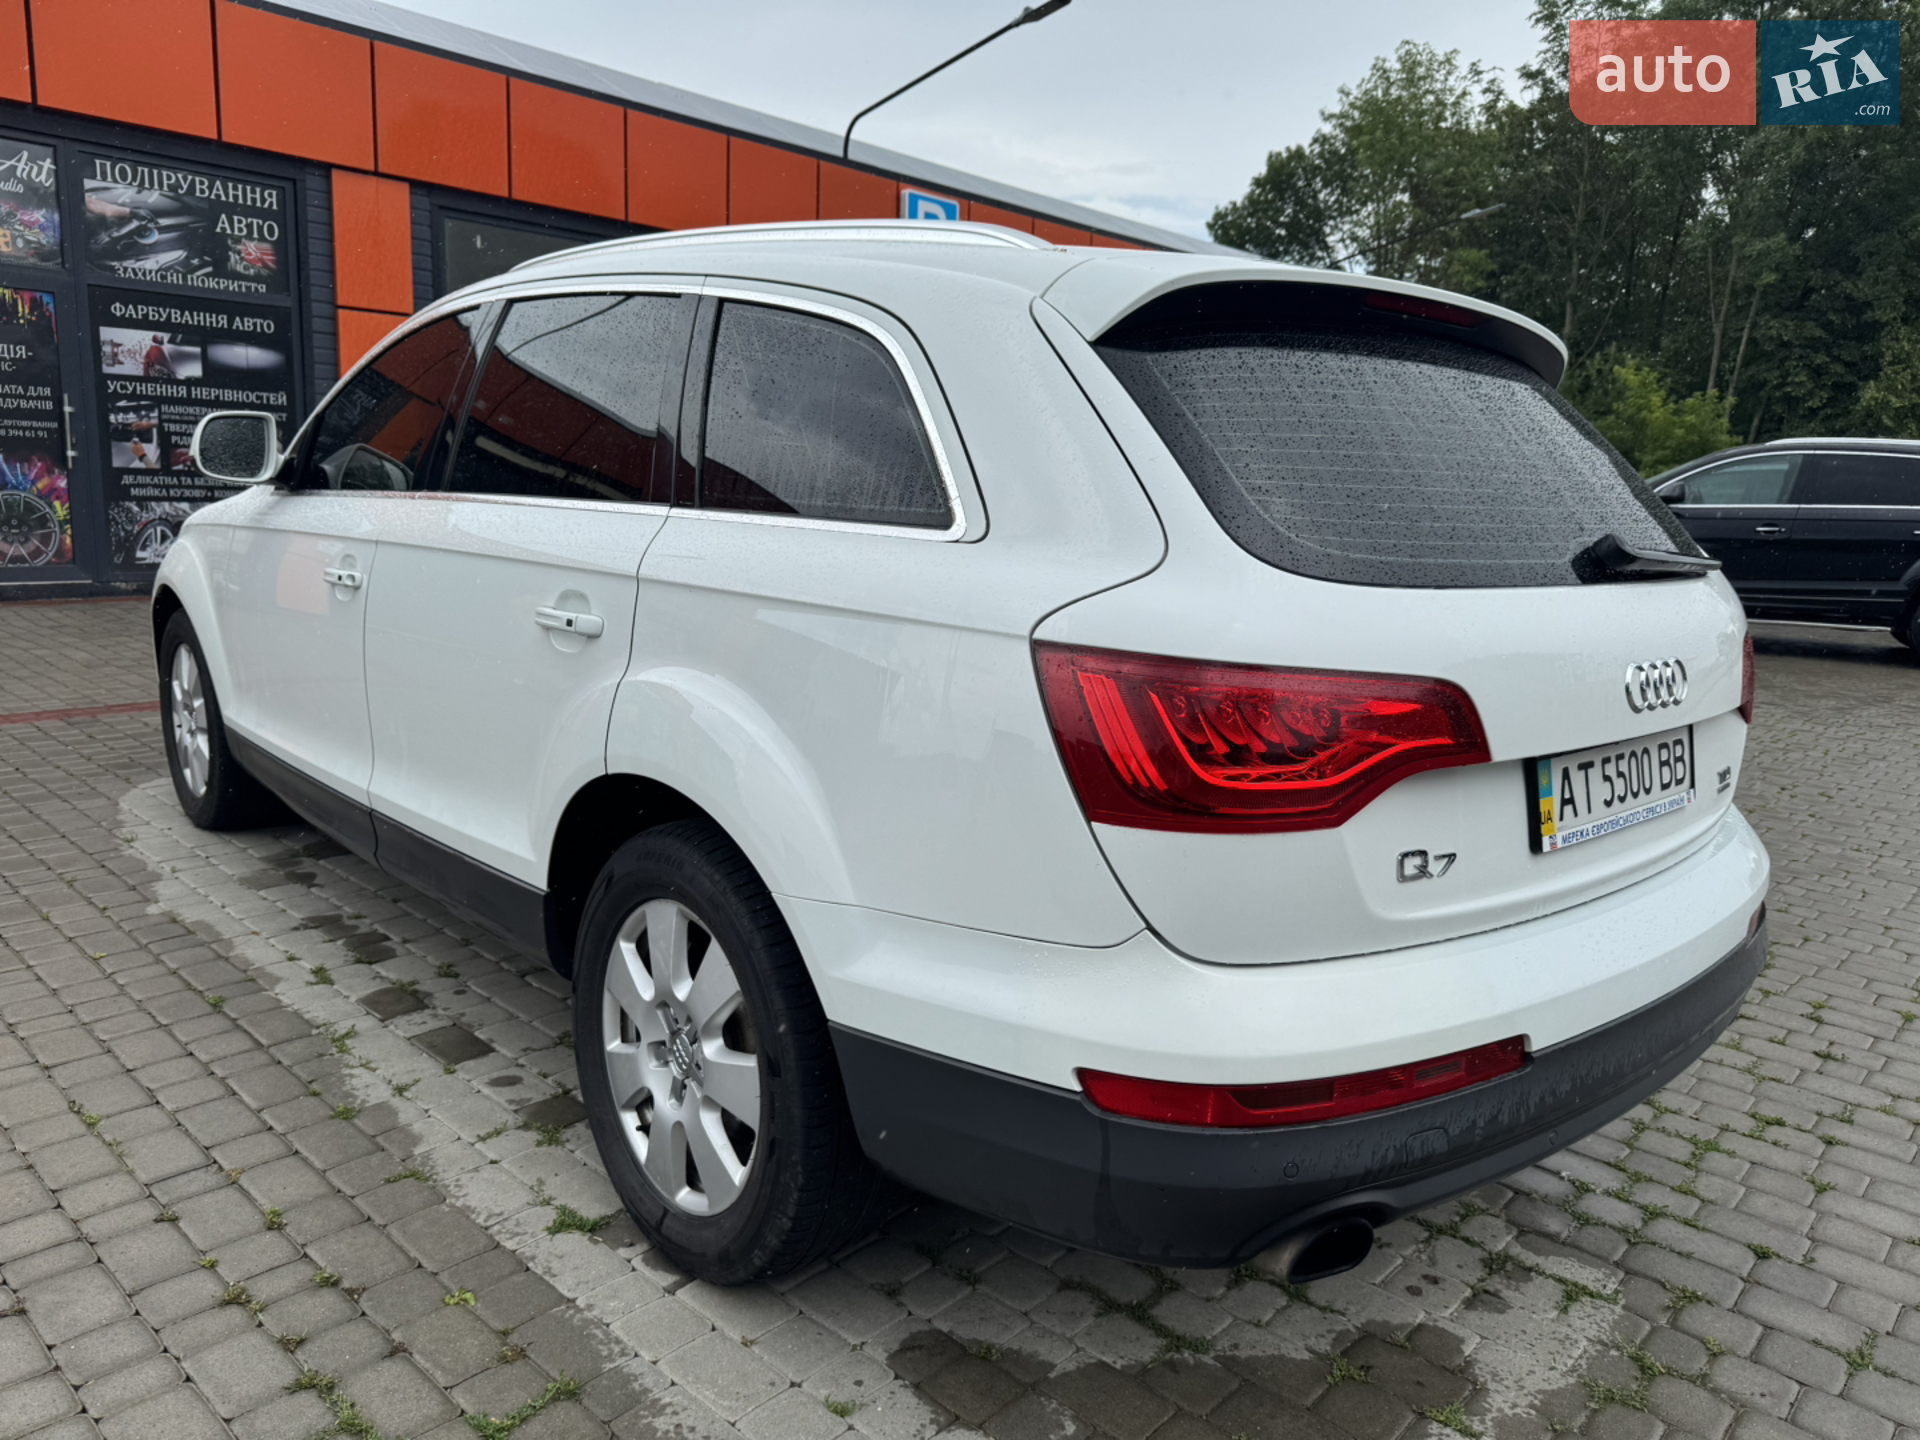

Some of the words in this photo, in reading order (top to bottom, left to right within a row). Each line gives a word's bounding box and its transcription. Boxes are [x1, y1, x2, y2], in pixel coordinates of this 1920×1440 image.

[0, 150, 57, 187] Art
[94, 159, 278, 210] ПОЛІРУВАННЯ
[215, 213, 279, 241] АВТО
[110, 301, 228, 329] ФАРБУВАННЯ
[232, 316, 275, 334] АВТО
[26, 385, 52, 398] ДЛЯ
[107, 379, 188, 399] УСУНЕННЯ
[191, 385, 288, 406] НЕРІВНОСТЕЙ
[7, 429, 24, 438] 394
[24, 430, 36, 439] 61
[36, 431, 48, 439] 91
[121, 474, 178, 486] ДЕЛІКАТНА
[179, 477, 193, 486] ТА
[130, 487, 168, 498] МИЙКА
[1558, 760, 1595, 822] AT
[1601, 746, 1653, 809] 5500
[1658, 738, 1687, 791] BB
[1540, 809, 1553, 826] UA
[1561, 827, 1590, 845] МЕРЕЖА
[1591, 811, 1641, 836] ЄВРОПЕЙСЬКОГО
[1396, 849, 1457, 883] Q7
